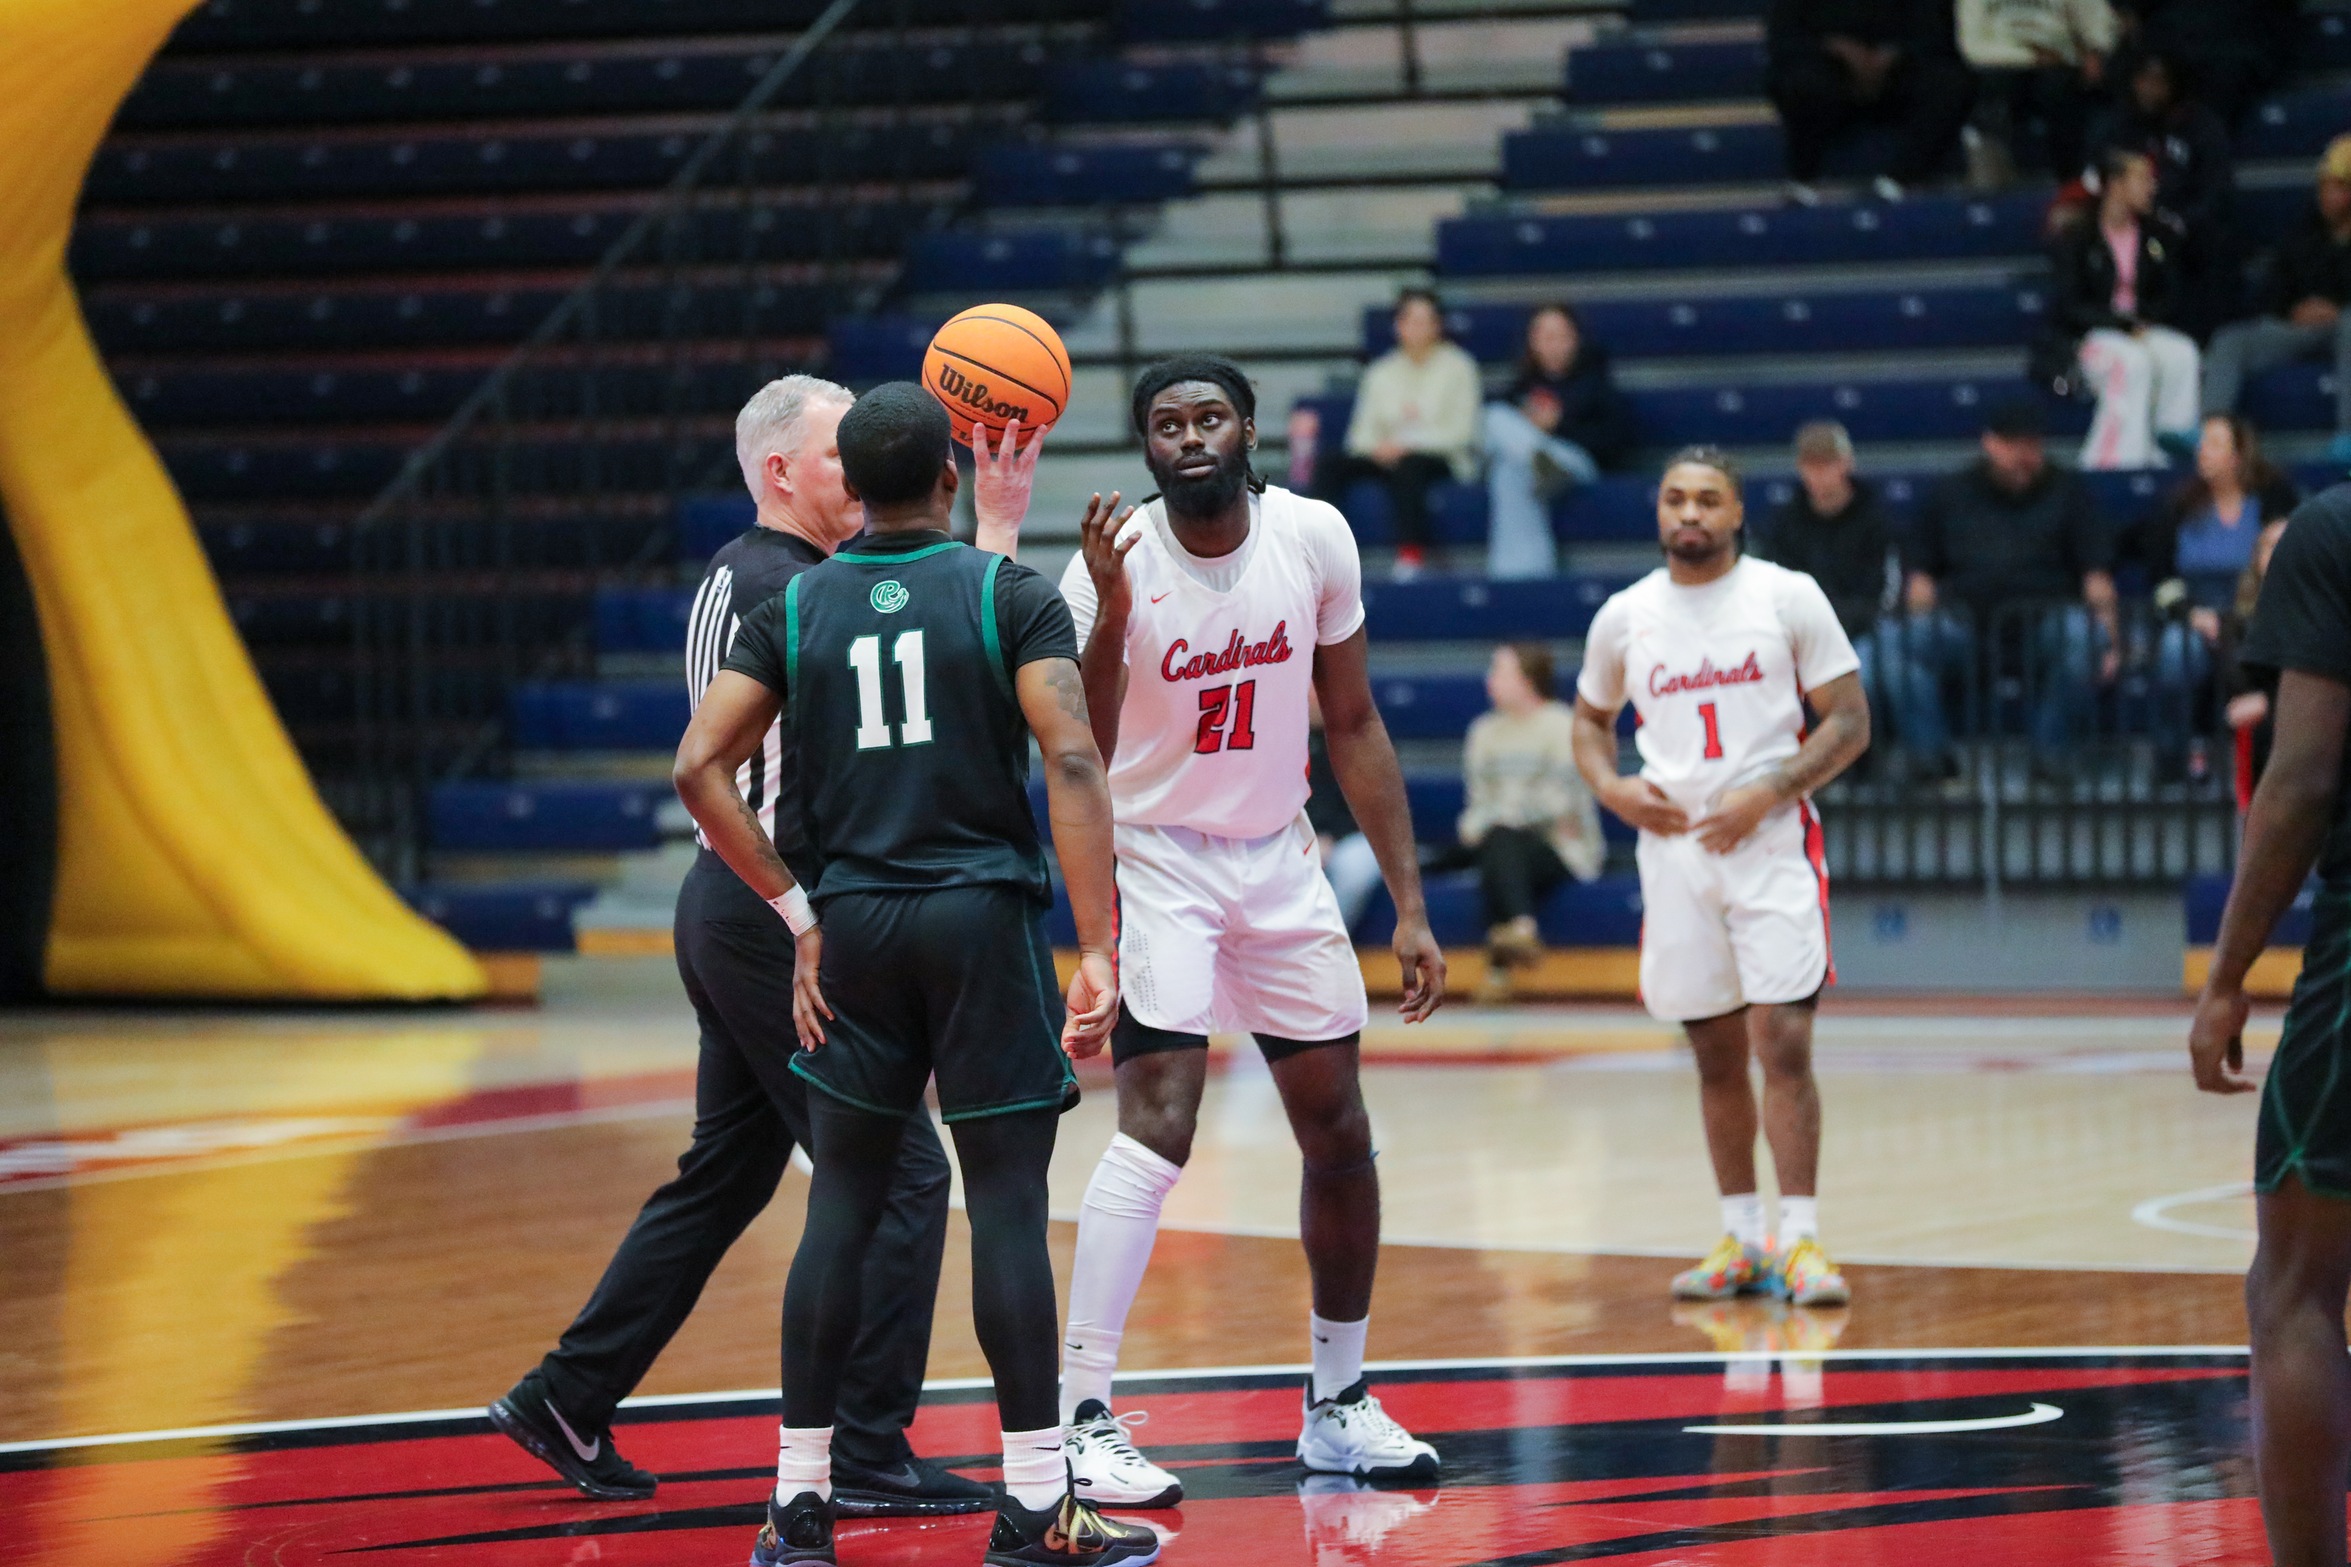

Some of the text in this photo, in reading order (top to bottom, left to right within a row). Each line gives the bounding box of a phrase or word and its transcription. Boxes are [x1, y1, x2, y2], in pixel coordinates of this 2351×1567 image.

[939, 363, 1029, 424] Wilson
[1161, 620, 1293, 682] Cardinals
[1649, 651, 1764, 697] Cardinals
[847, 628, 935, 752] 11
[1194, 679, 1256, 754] 21
[1698, 703, 1723, 760] 1
